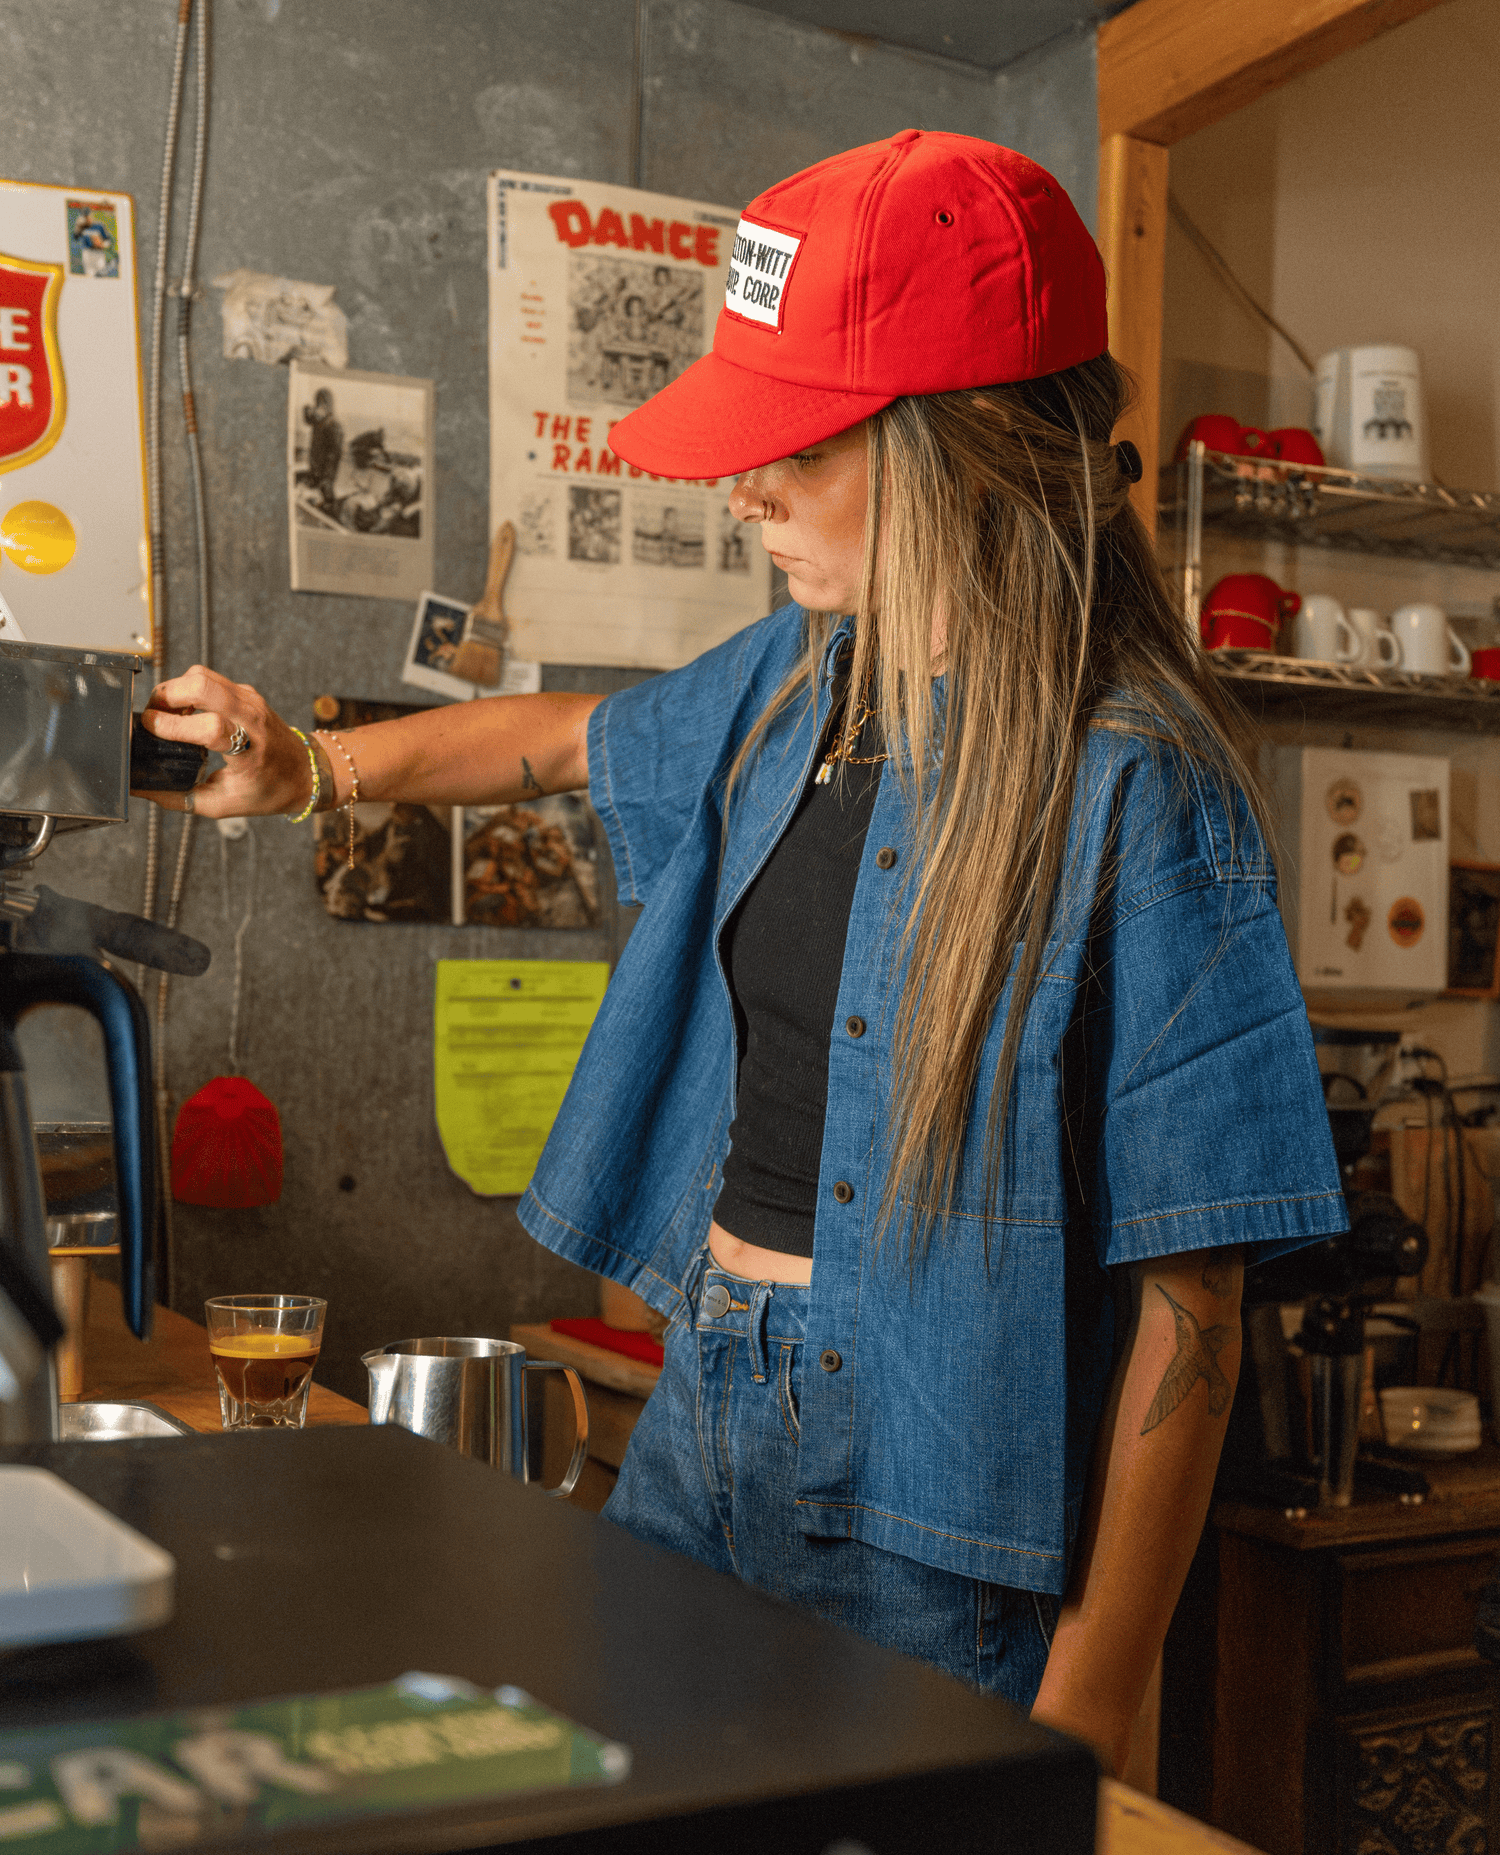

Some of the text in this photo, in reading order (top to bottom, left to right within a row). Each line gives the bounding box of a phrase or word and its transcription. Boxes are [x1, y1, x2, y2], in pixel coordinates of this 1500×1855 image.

[546, 200, 720, 267] DANCE
[743, 275, 780, 311] CORP.
[533, 411, 592, 443] THE
